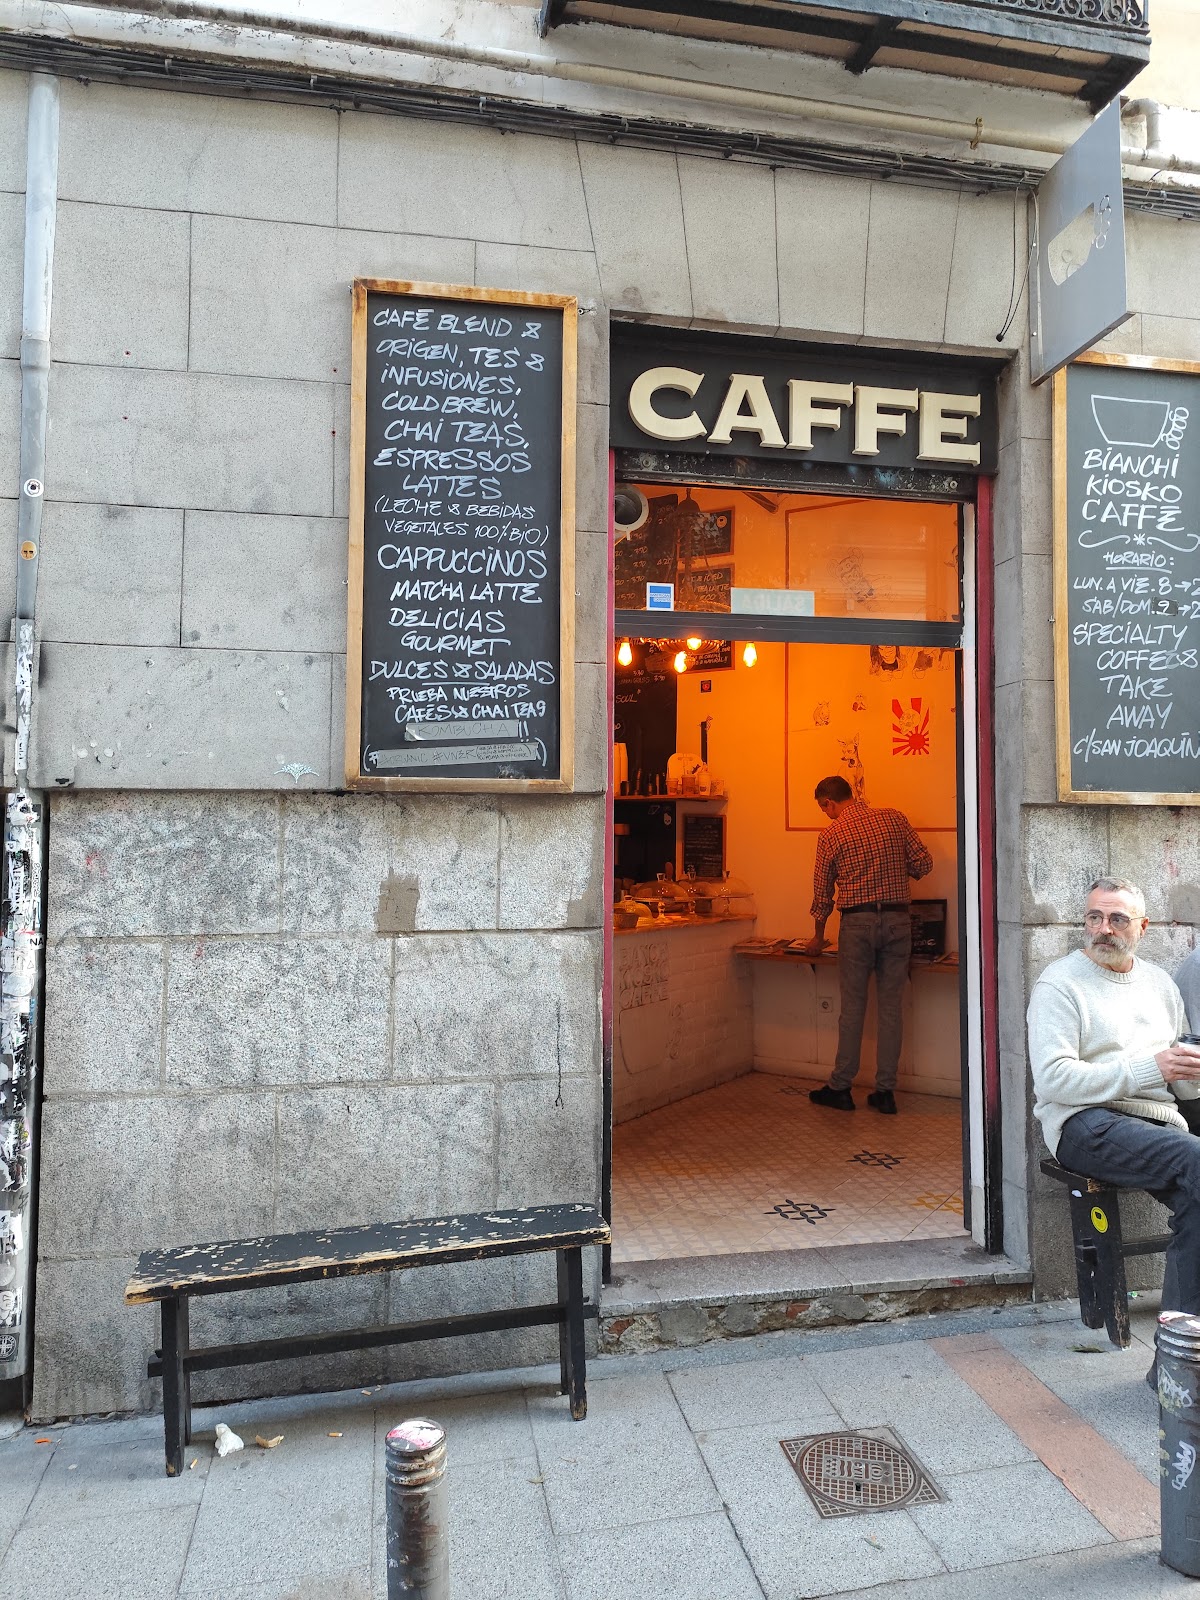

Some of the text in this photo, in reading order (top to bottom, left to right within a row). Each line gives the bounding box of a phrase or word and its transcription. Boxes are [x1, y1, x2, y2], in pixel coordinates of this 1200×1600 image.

[437, 313, 513, 337] BLEND
[375, 337, 464, 368] ORIGEN,
[468, 346, 521, 369] TES
[380, 363, 522, 396] INFUSIONES,
[381, 390, 519, 420] COLD BREW,
[628, 366, 982, 467] CAFFE
[384, 418, 529, 450] CHAI TEAS,
[373, 447, 532, 473] ESPRESSOS
[1082, 447, 1180, 479] BIANCHI
[402, 474, 503, 500] LATTES
[1086, 474, 1183, 504] KIOSKO
[374, 494, 443, 517] (LECHE
[465, 502, 536, 520] BEBIDAS
[384, 518, 470, 537] VEGETALES
[377, 543, 548, 579] CAPPUCCINOS
[1102, 550, 1175, 568] HORARIO:
[389, 579, 543, 604] MATCHA LATTE
[1073, 577, 1104, 591] LUN.
[1106, 577, 1117, 594] A
[1158, 576, 1173, 596] 8
[388, 606, 506, 633] DELICIAS
[400, 630, 512, 657] GOURMET
[1073, 621, 1188, 650] SPECIALTY
[368, 659, 449, 681] DULCES
[474, 659, 555, 684] SALADAS
[385, 683, 531, 703] PRUEBA NUESTROS
[1099, 674, 1173, 700] TAKE
[471, 700, 510, 719] CHAI
[1106, 701, 1173, 729] AWAY
